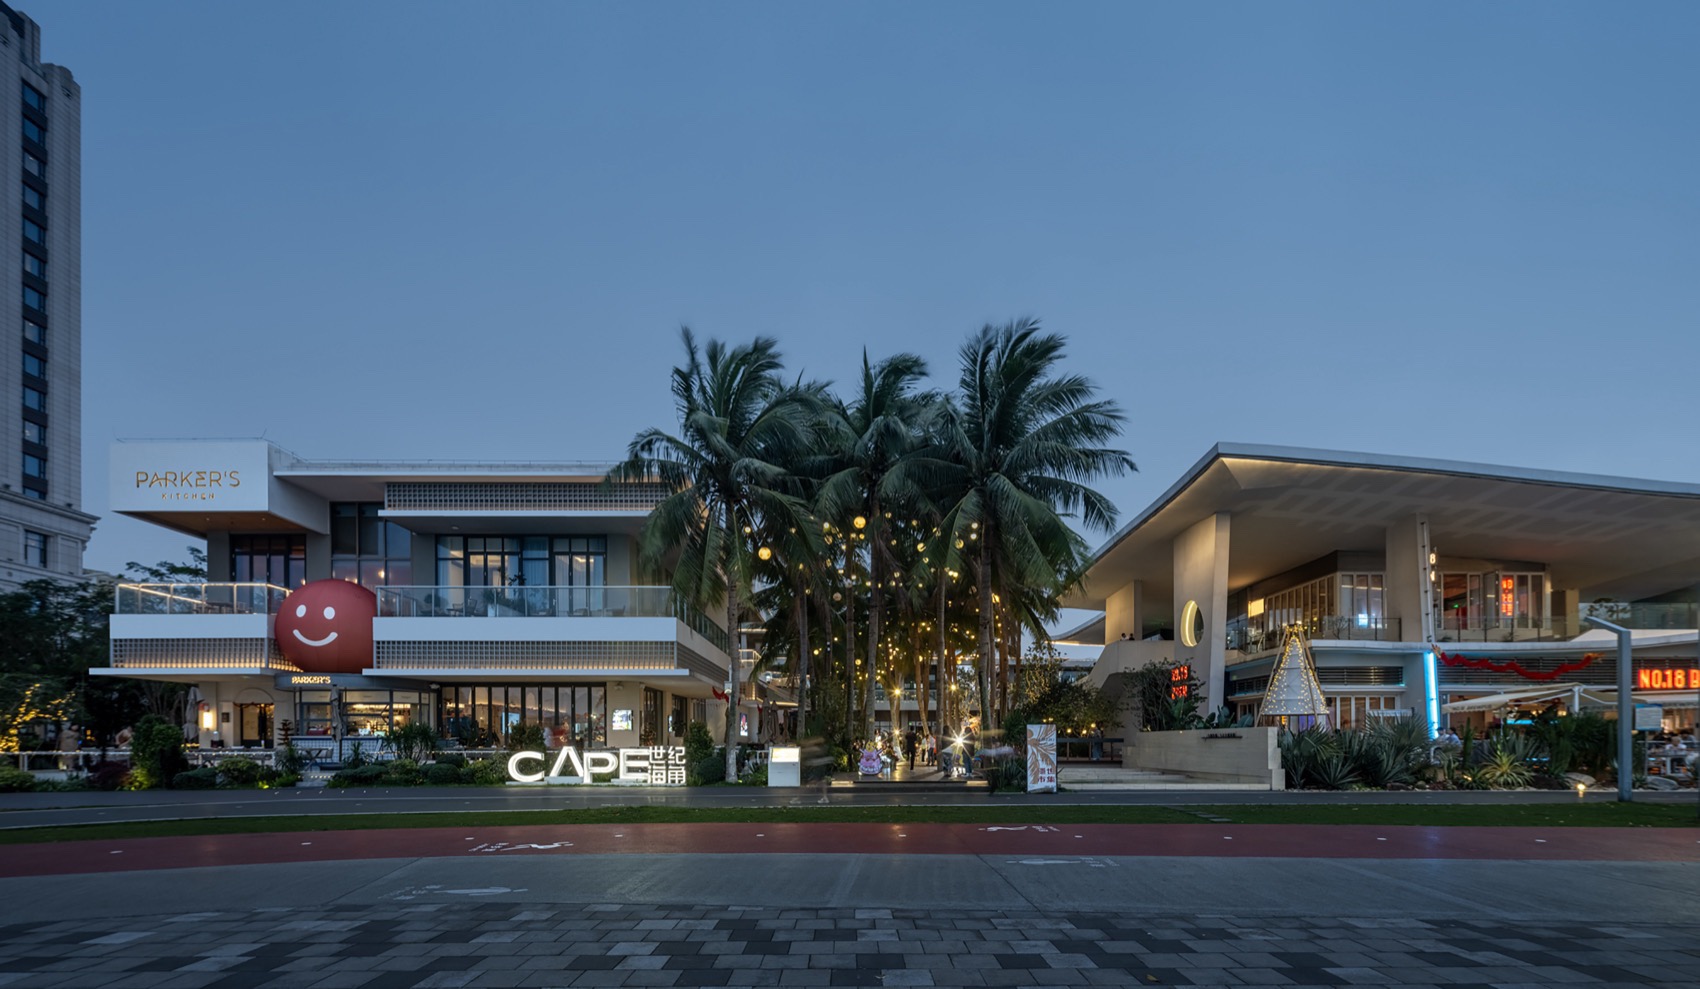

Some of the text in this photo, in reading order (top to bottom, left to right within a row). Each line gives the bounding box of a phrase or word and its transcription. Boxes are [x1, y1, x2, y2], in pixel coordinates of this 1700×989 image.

[136, 470, 241, 488] PARKER'S
[162, 492, 215, 500] KITCHEN
[291, 675, 331, 684] PARKER'S
[1638, 668, 1686, 689] NO.18
[648, 745, 686, 764] 世纪
[507, 745, 649, 784] CAPE
[648, 764, 686, 785] 海角
